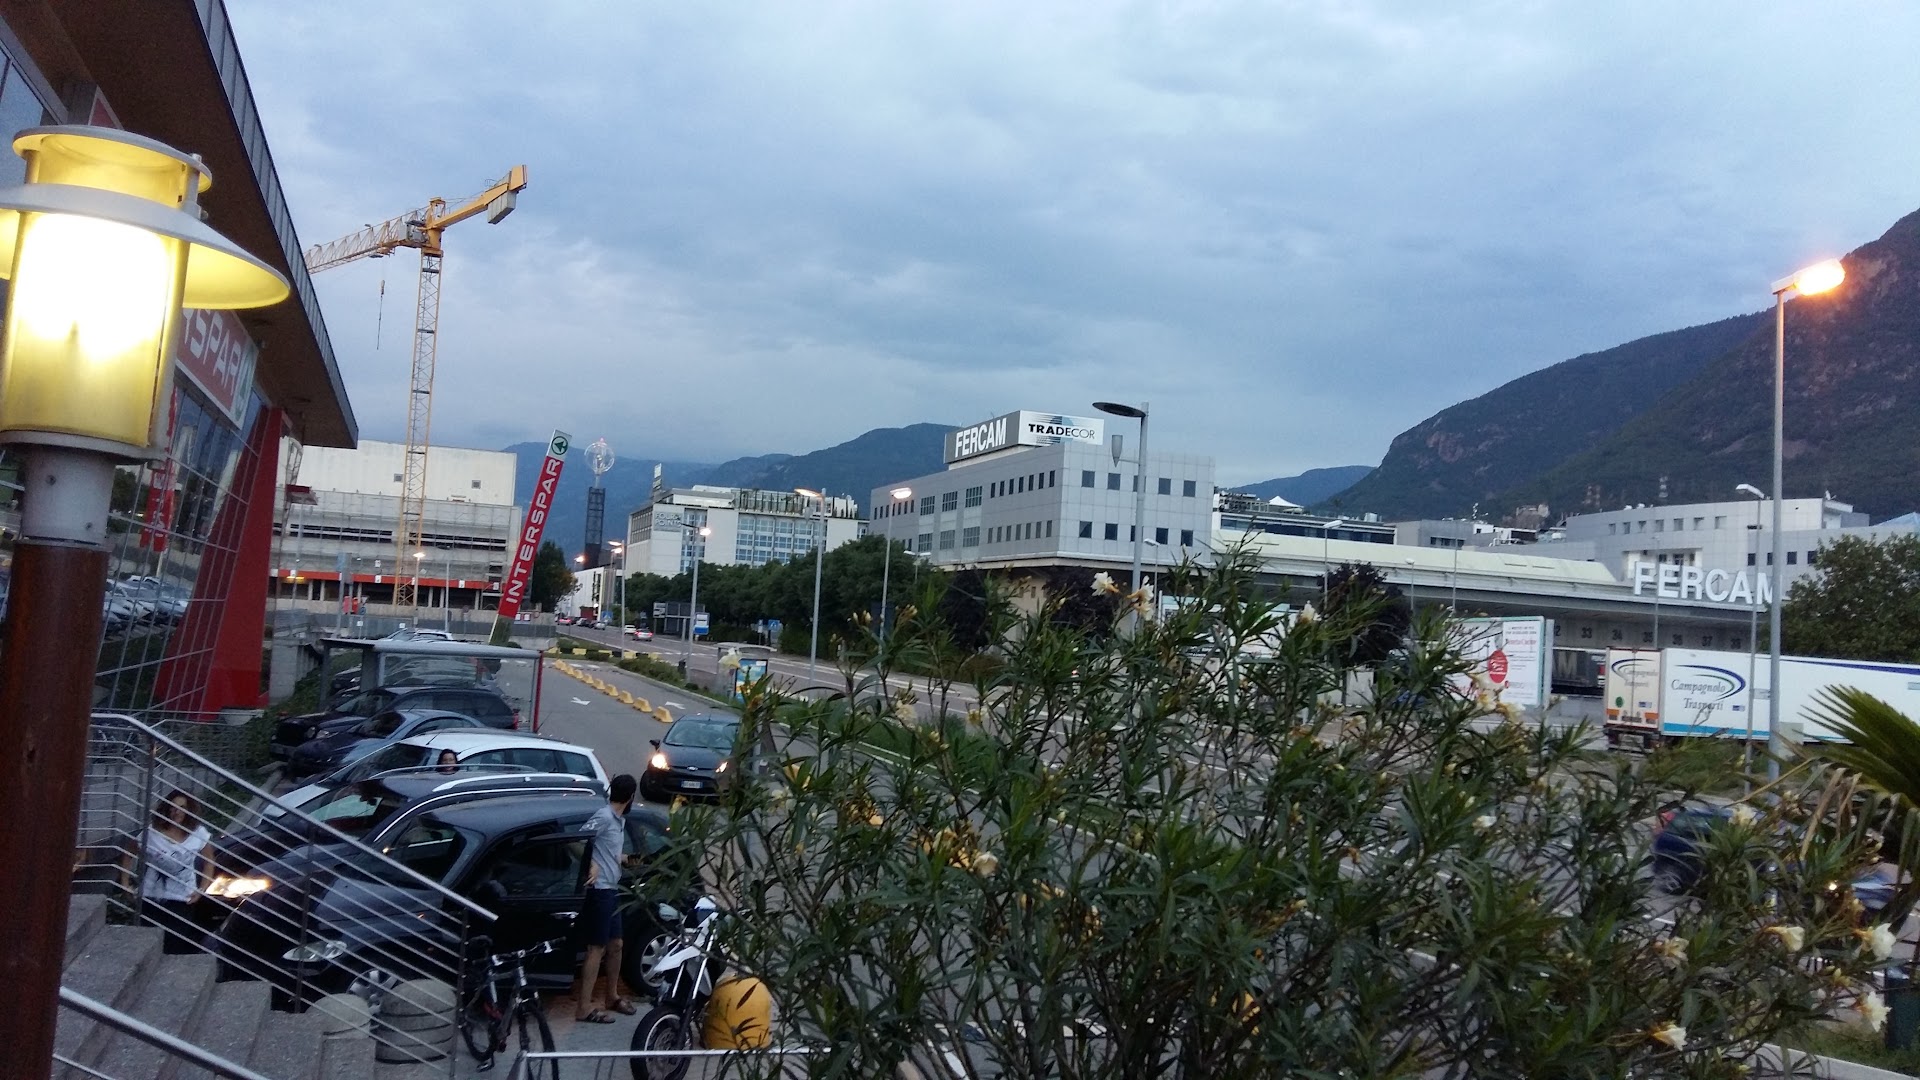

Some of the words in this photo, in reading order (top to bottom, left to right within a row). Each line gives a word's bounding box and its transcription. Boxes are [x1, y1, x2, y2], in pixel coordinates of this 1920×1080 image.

[954, 417, 1007, 458] FERCAM
[1028, 423, 1096, 439] TRADECOR
[505, 458, 561, 604] INTERSPAR
[1581, 627, 1592, 639] 33
[1612, 629, 1623, 641] 34
[1702, 636, 1713, 647] 37
[1671, 678, 1727, 695] Campagnolo
[1683, 697, 1724, 713] Trasporti
